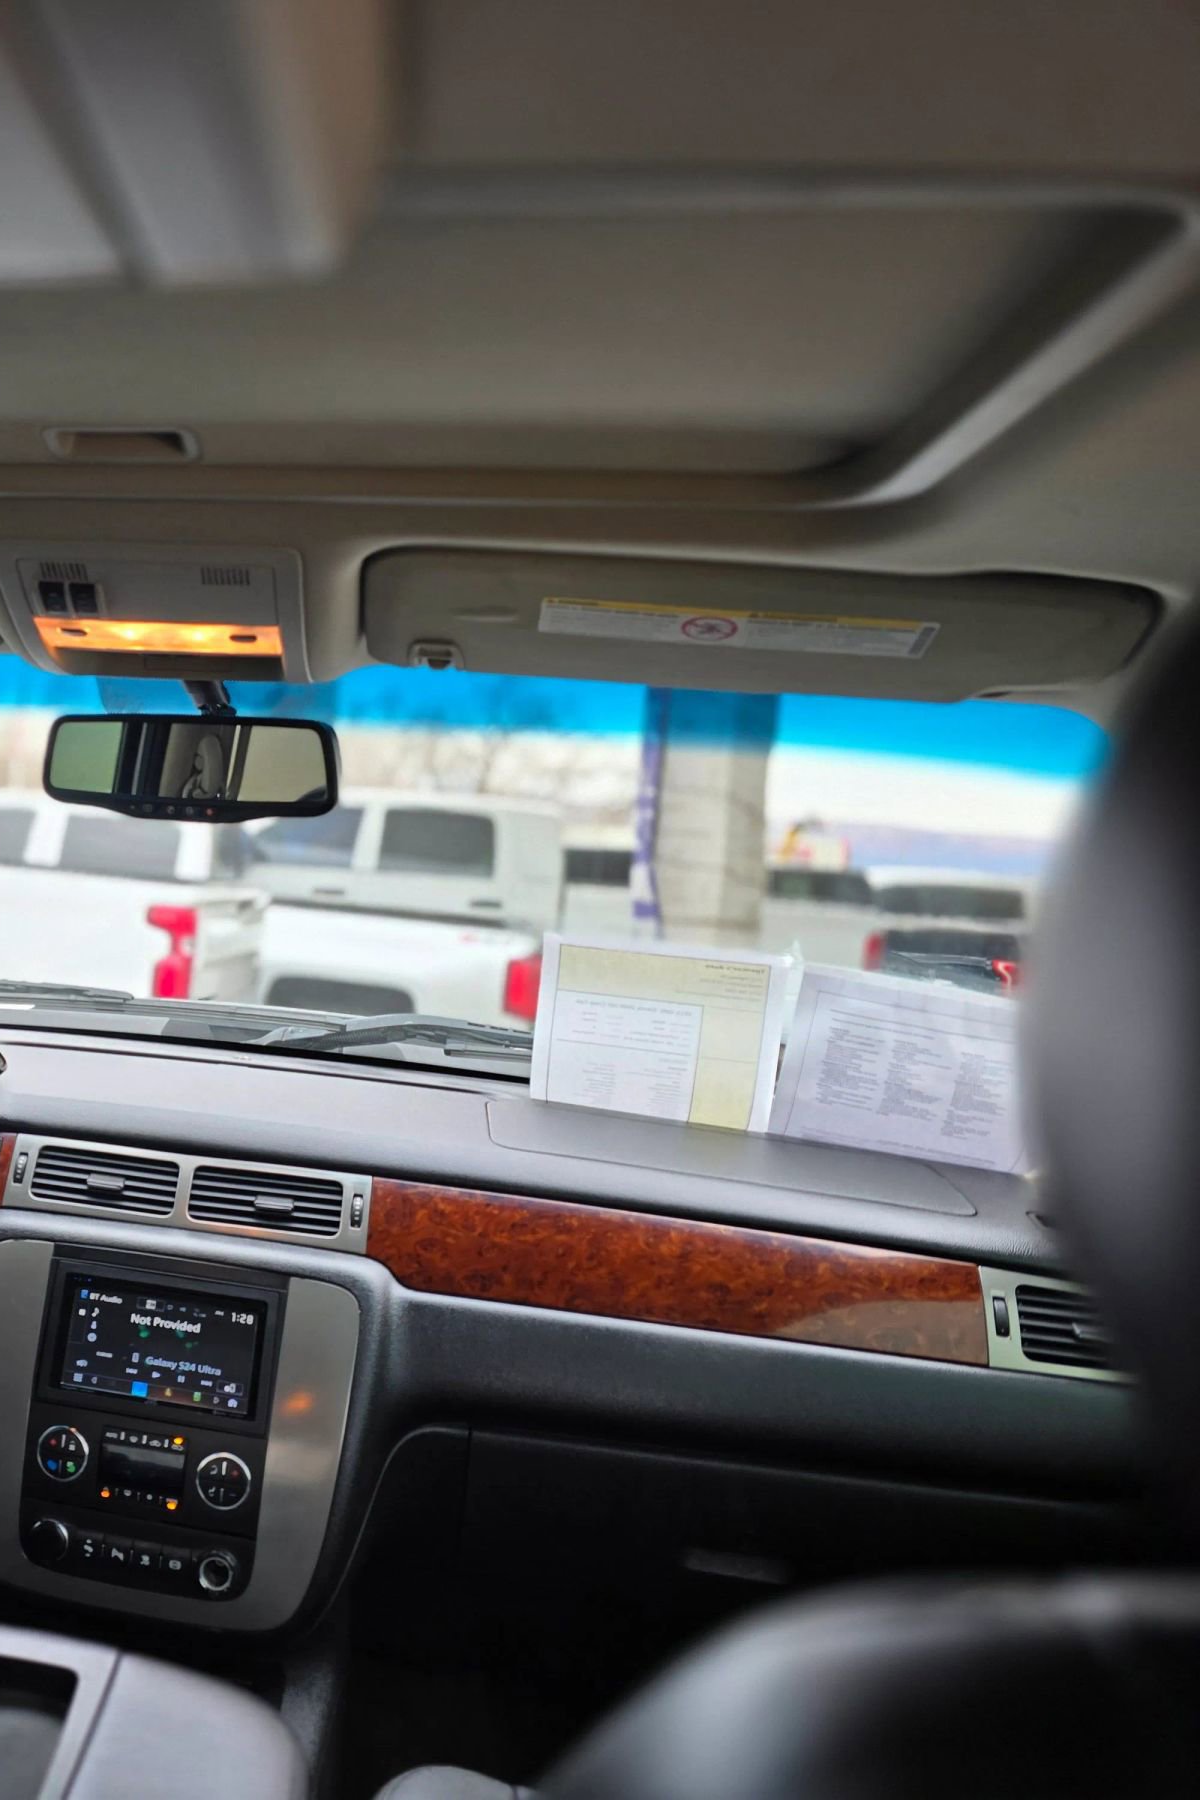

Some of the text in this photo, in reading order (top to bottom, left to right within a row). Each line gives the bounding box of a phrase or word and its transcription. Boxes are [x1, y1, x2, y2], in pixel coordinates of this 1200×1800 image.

[89, 1292, 123, 1304] BT Audio
[130, 1313, 202, 1333] Not Provided
[144, 1356, 222, 1376] Galaxy S24 Ultra
